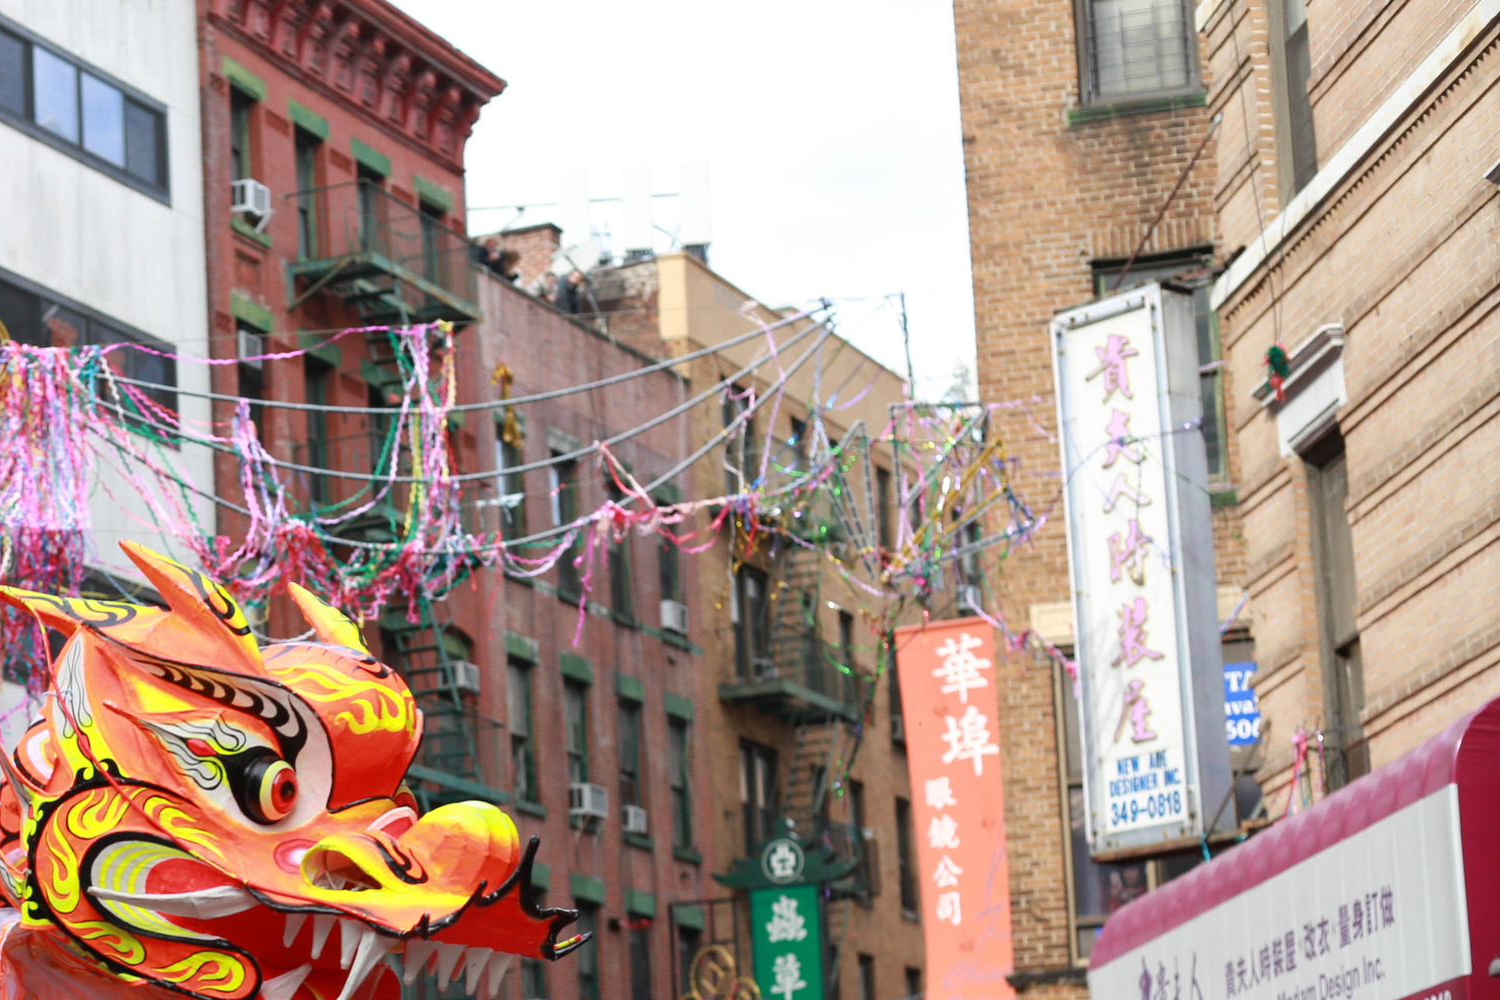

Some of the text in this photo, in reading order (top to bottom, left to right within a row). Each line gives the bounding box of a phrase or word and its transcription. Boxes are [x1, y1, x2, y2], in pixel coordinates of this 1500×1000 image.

[931, 632, 999, 776] 華埠
[1117, 755, 1140, 776] NEW
[1110, 768, 1181, 798] DESIGNER INC.
[1111, 791, 1182, 826] 349-0818
[924, 776, 964, 927] 眼鏡公司
[1363, 954, 1387, 986] Inc.
